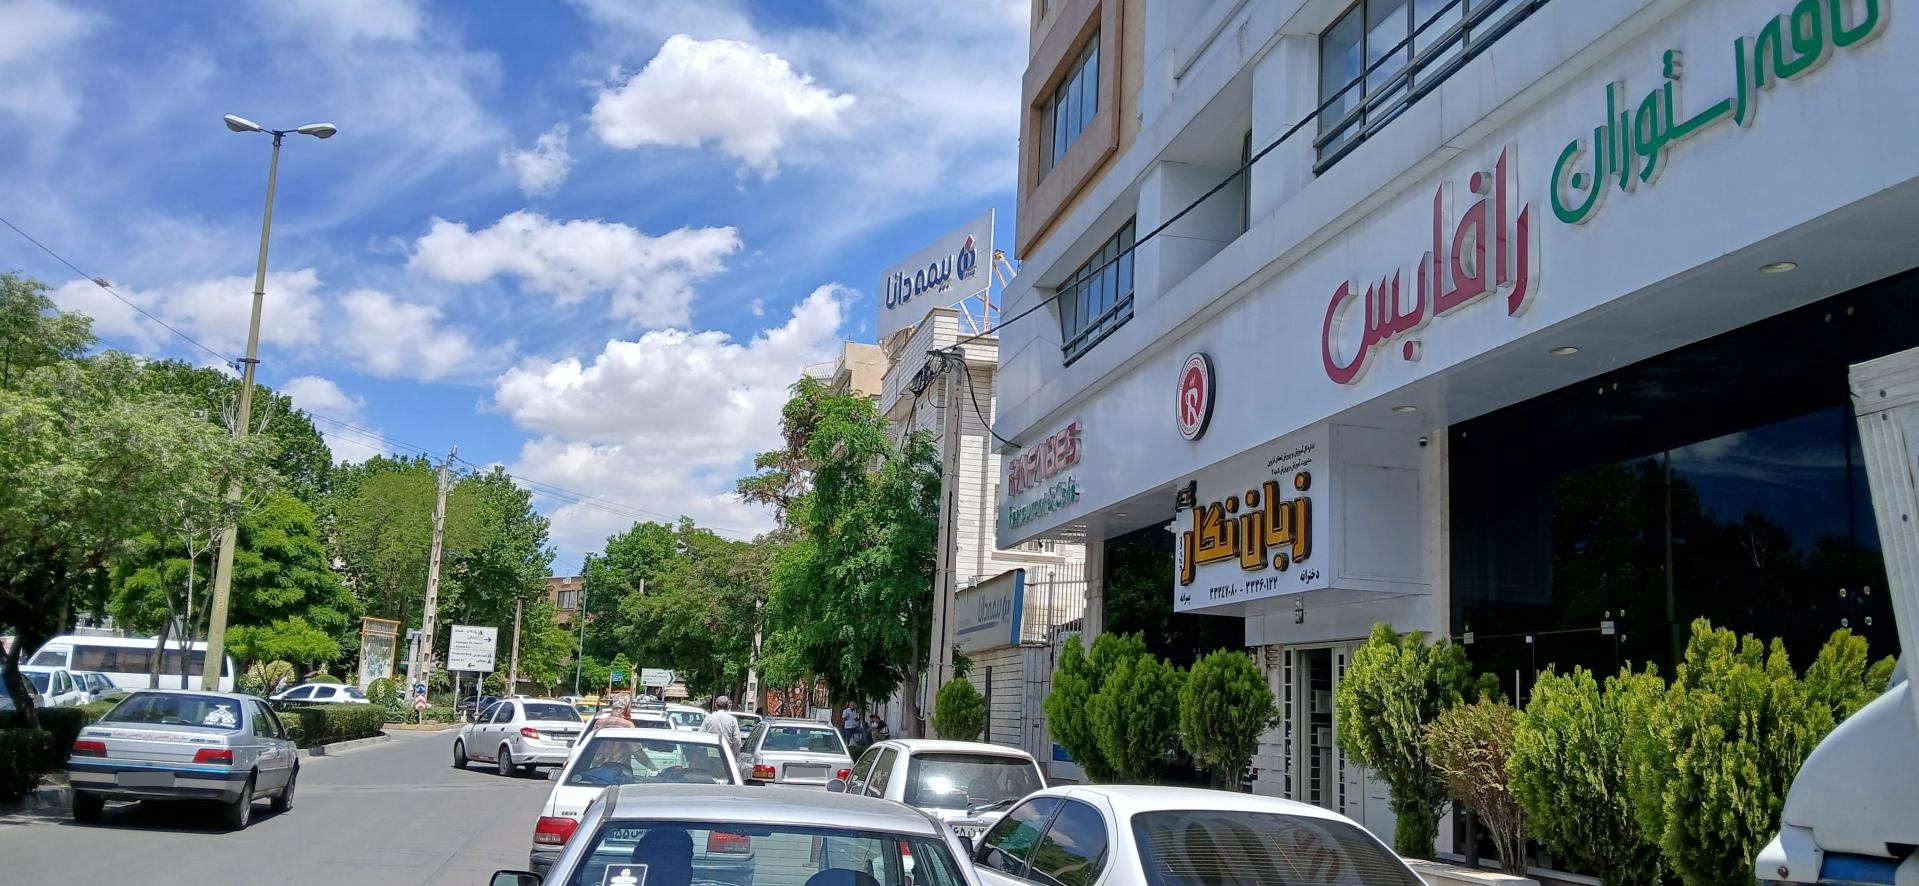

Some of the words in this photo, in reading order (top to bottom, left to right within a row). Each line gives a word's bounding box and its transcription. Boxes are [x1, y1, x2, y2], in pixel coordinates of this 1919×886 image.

[1550, 36, 1757, 225] رستوران
[886, 271, 914, 310] دانا
[914, 253, 953, 296] بیمه
[1321, 143, 1540, 386] رافابس
[1180, 496, 1241, 586] نگار
[1240, 471, 1313, 572] زبان
[1180, 593, 1191, 605] پسرانه
[1300, 569, 1320, 585] دخترانه
